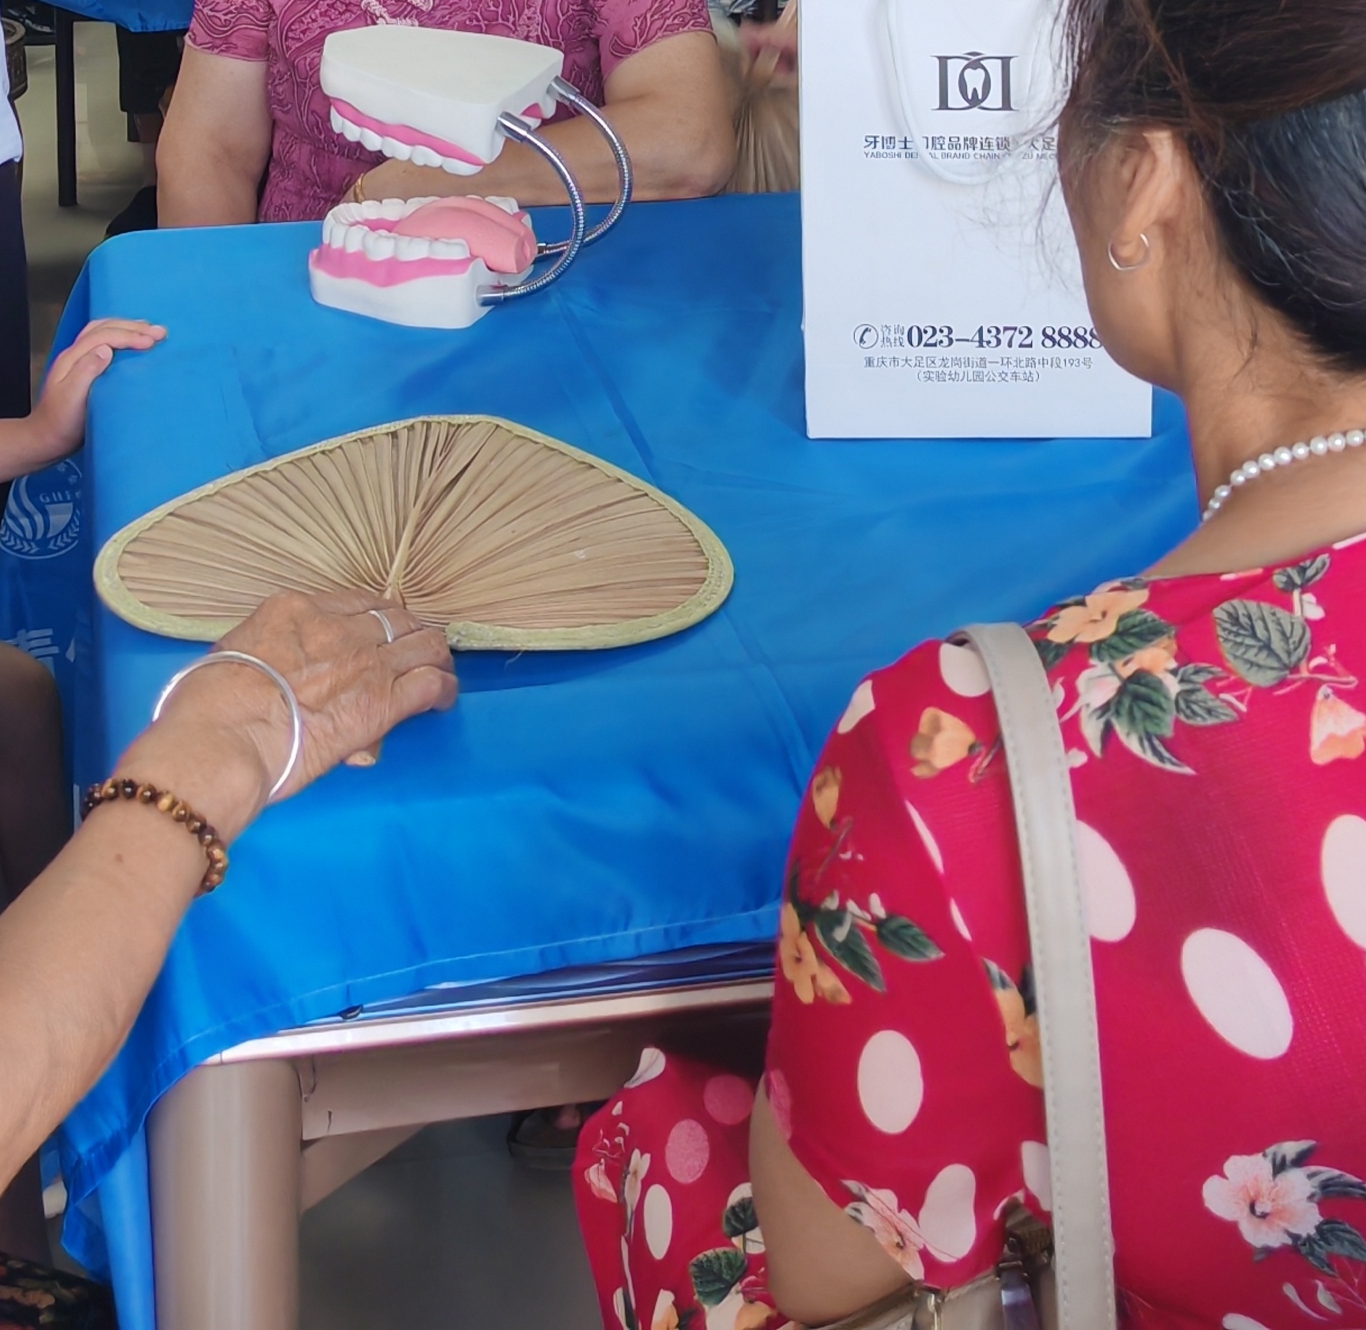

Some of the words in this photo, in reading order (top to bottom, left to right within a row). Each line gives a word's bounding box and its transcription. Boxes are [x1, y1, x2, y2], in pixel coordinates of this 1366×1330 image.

[864, 151, 902, 159] YABOSHI
[940, 151, 971, 160] BRAND
[973, 152, 1001, 160] CHAIN
[906, 325, 1033, 349] 023-4372
[1040, 326, 1104, 349] 8888
